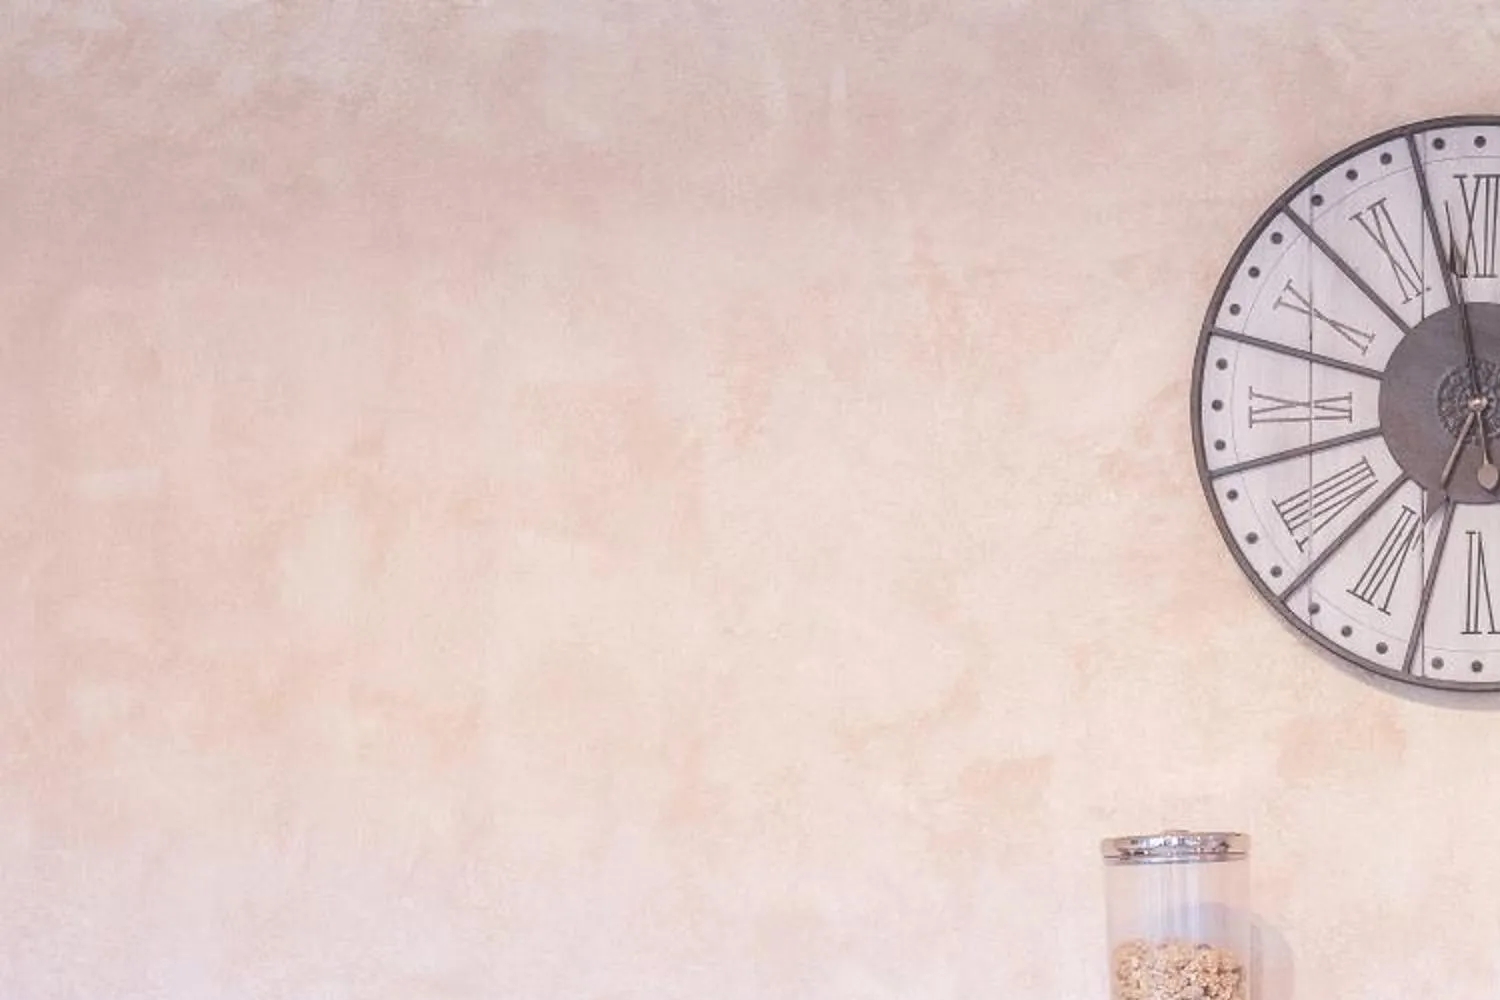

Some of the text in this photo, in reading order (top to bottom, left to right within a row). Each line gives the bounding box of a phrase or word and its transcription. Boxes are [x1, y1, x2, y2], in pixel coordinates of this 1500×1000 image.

[1349, 197, 1431, 304] XI
[1273, 279, 1376, 355] X
[1249, 385, 1352, 428] IX
[1272, 456, 1378, 552] VIII
[1346, 504, 1420, 615] VII
